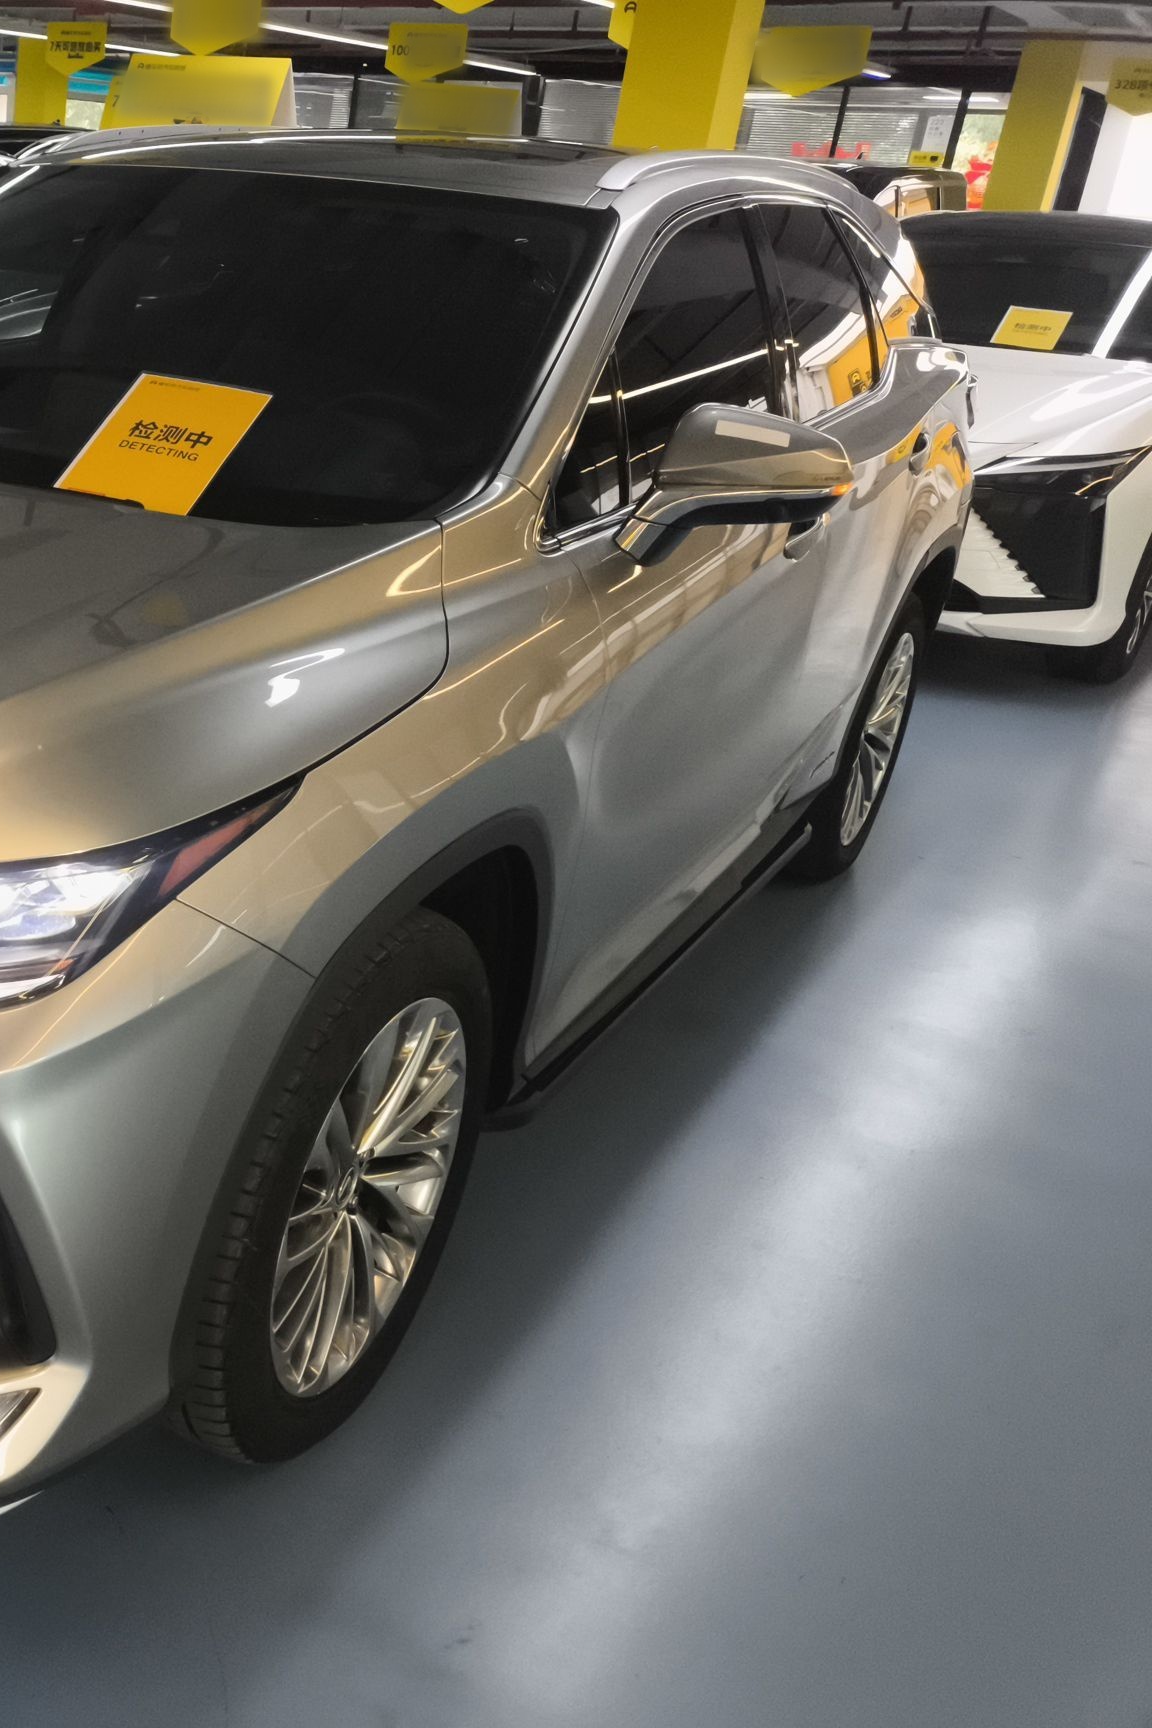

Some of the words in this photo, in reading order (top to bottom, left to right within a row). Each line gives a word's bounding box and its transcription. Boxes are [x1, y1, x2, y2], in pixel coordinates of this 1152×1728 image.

[129, 420, 213, 448] 检测中
[118, 439, 199, 462] DETECTING
